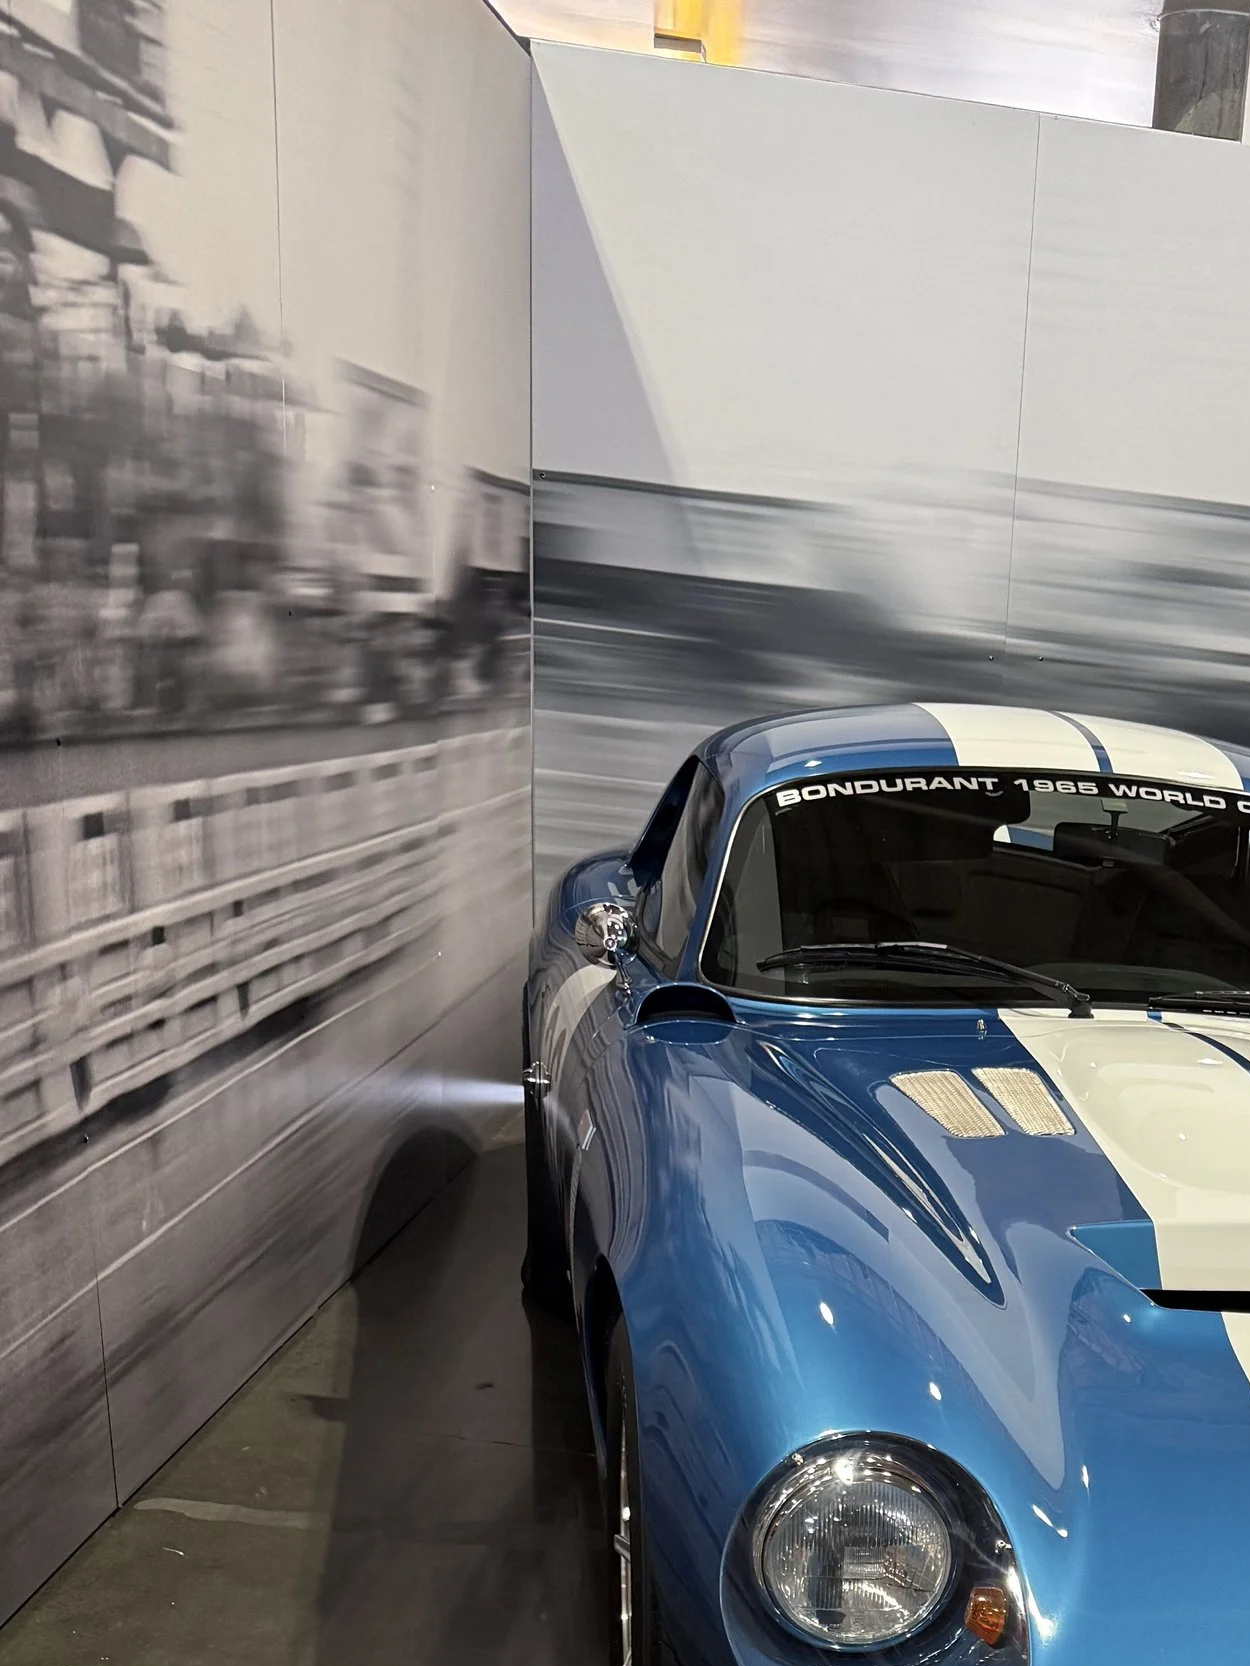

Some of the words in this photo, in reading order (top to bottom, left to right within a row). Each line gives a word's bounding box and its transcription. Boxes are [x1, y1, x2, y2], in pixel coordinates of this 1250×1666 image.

[776, 776, 999, 807] BONDURANT
[1013, 779, 1099, 795] 1965
[1108, 783, 1227, 809] WORLD
